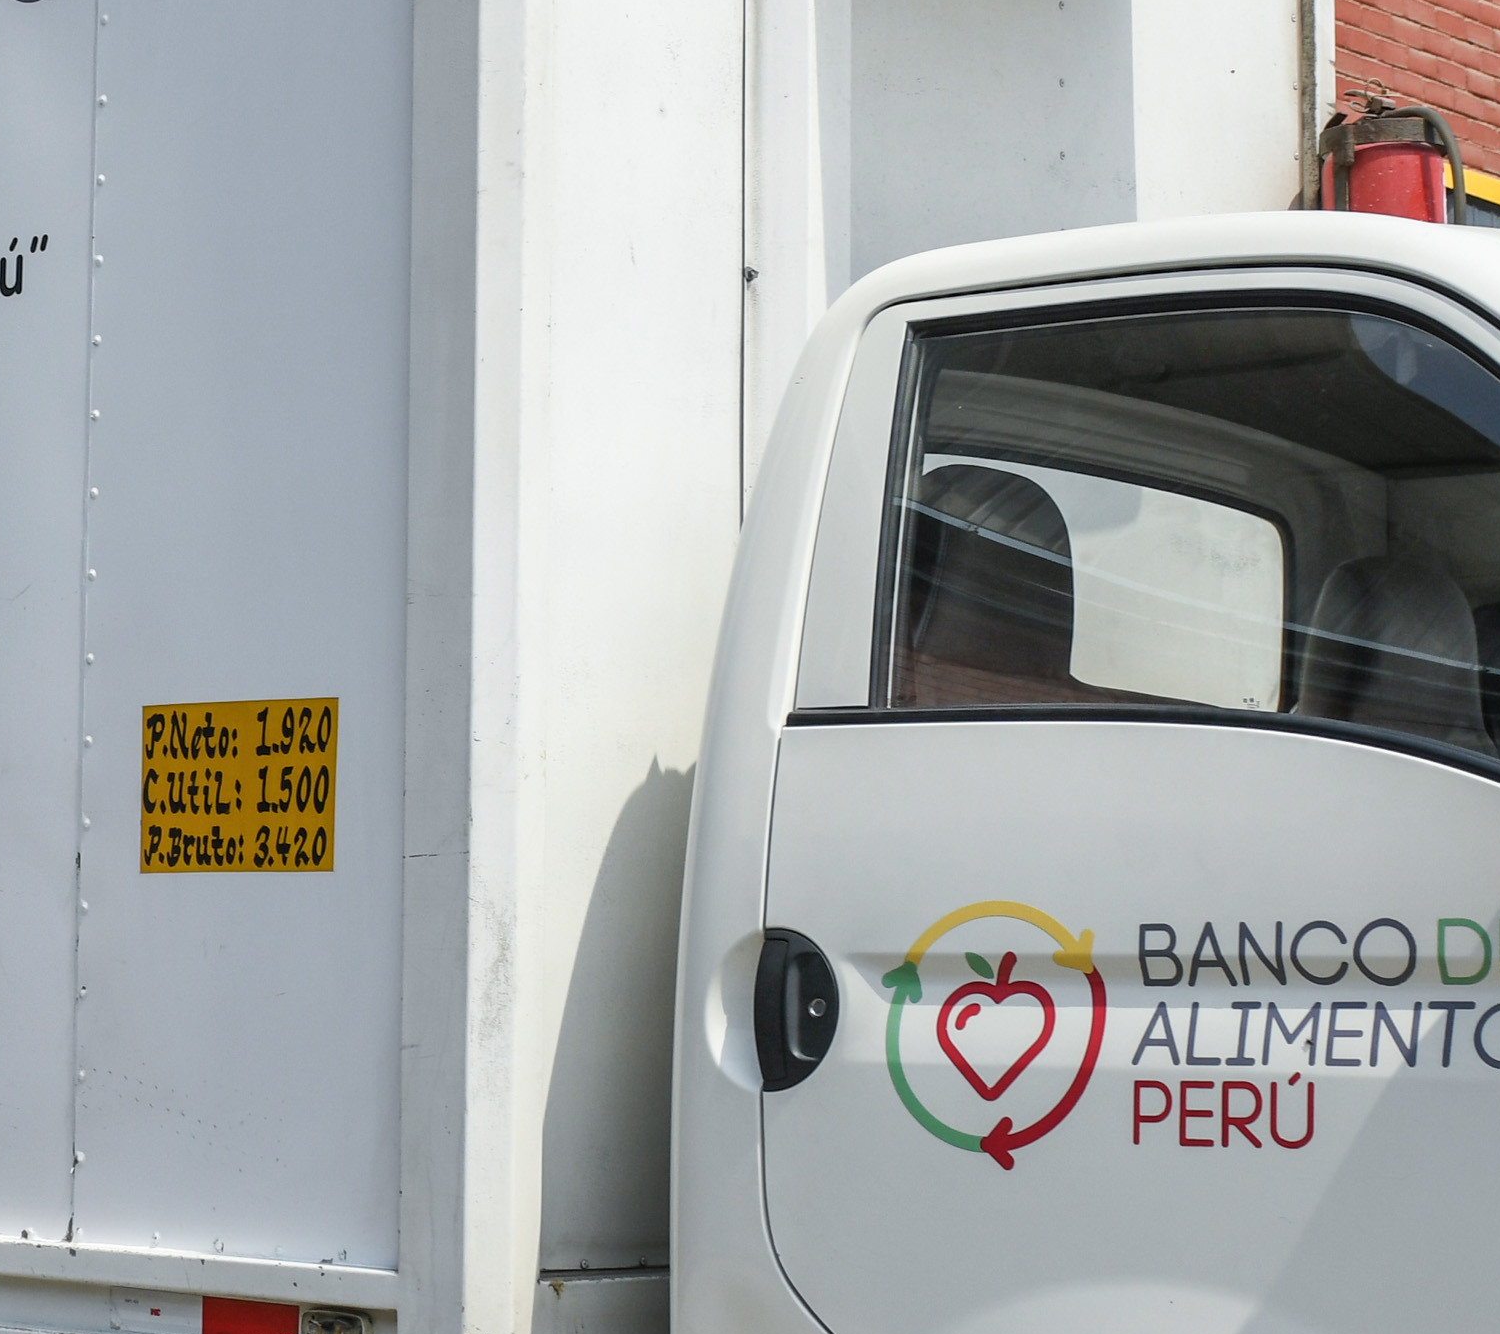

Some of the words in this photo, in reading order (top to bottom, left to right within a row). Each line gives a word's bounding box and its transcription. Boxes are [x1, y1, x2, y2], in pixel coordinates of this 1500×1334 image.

[145, 710, 238, 760] P.Neto:
[255, 705, 332, 757] 1.920
[256, 765, 330, 814] 1.500
[144, 825, 244, 868] P.Bruto:
[253, 825, 328, 868] 3.420
[1139, 918, 1416, 987] BANCO
[1131, 1072, 1315, 1150] PERÚ
